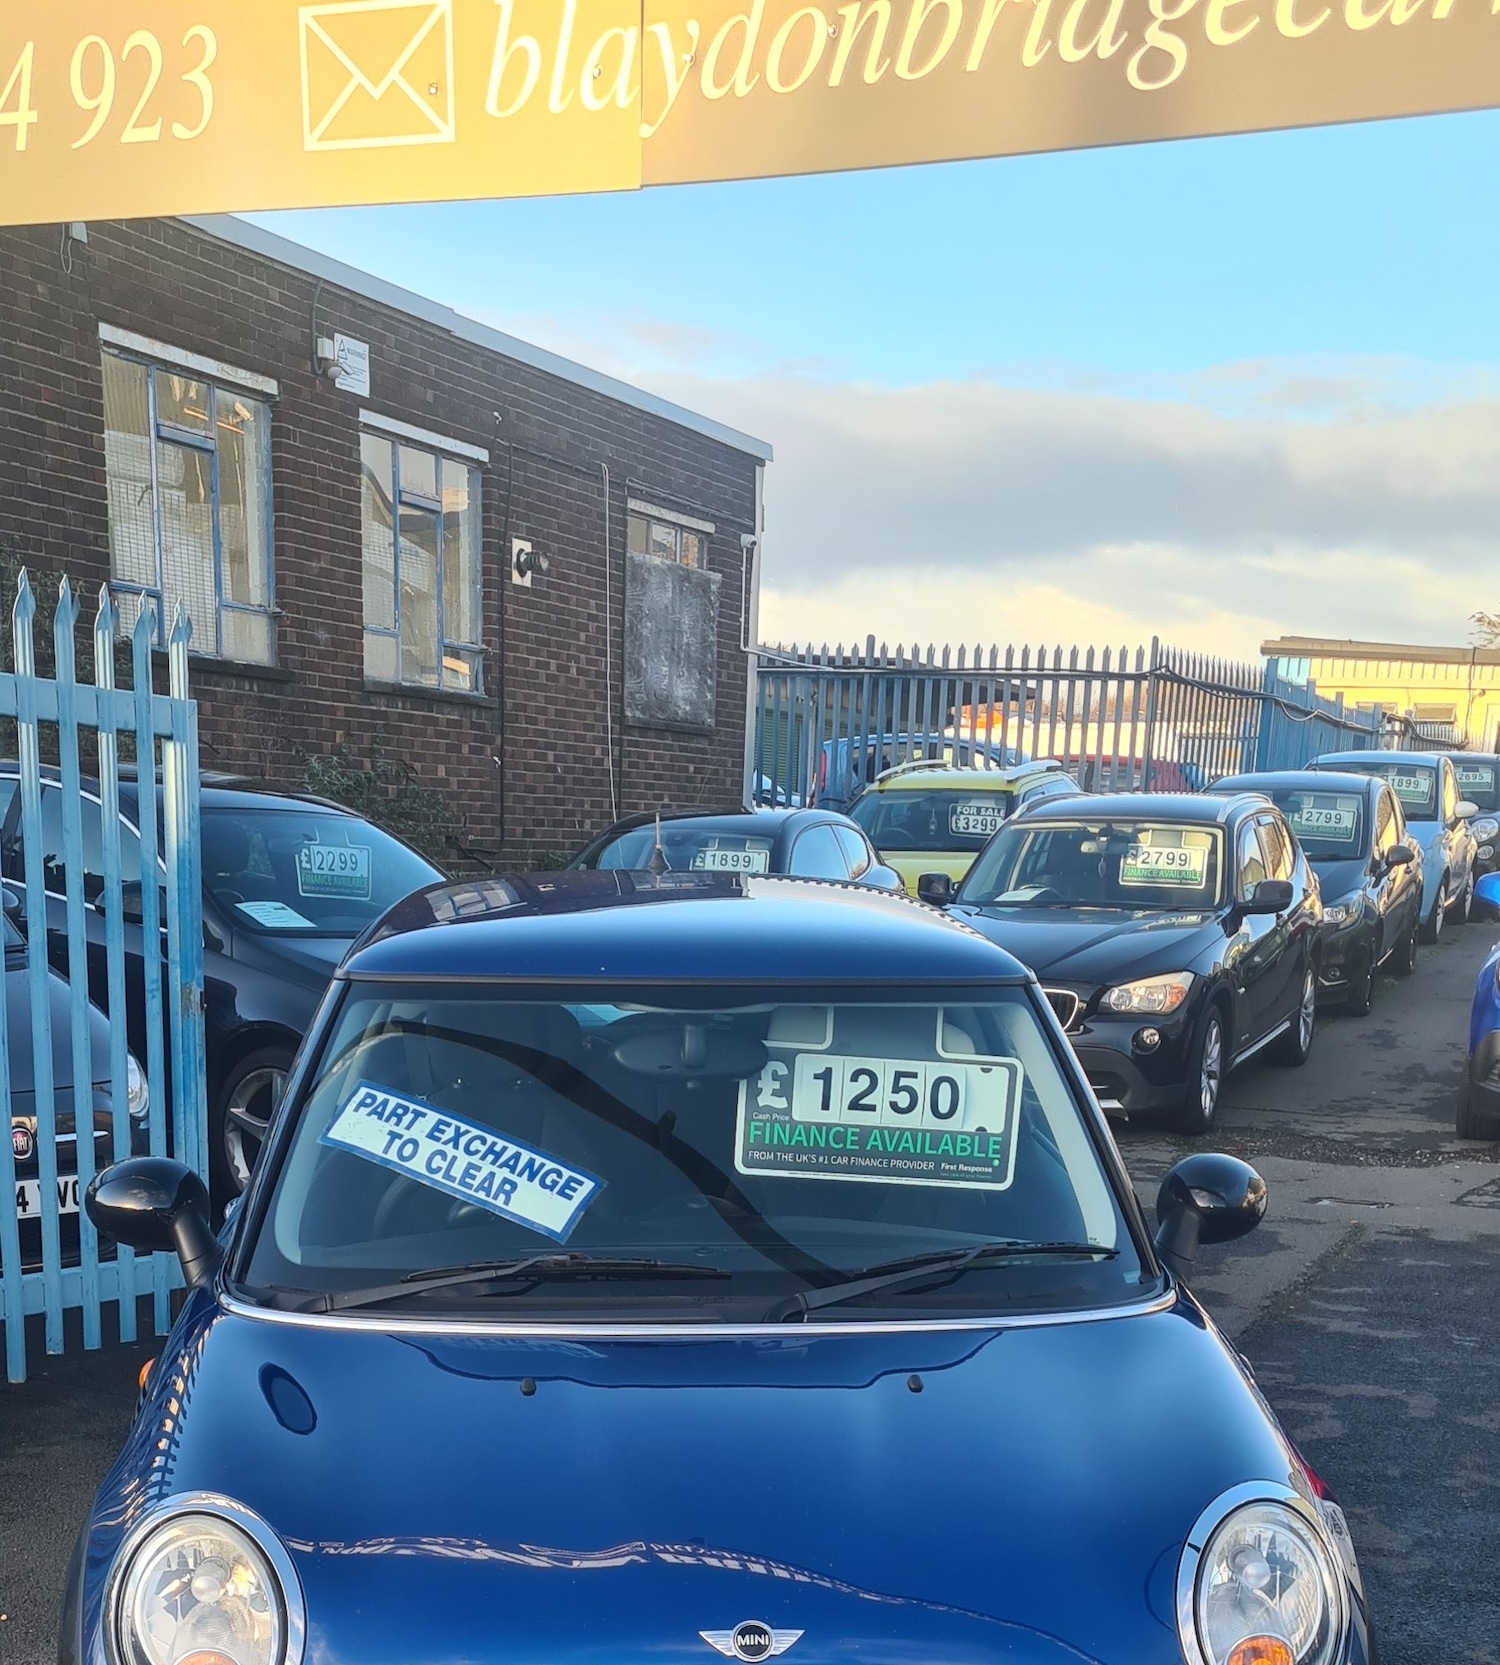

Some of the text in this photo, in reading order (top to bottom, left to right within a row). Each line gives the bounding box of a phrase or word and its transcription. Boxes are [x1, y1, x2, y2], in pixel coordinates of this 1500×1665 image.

[70, 25, 218, 150] 923
[957, 806, 977, 815] FOR
[752, 1111, 790, 1121] Cash Price
[352, 1091, 585, 1201] PART EXCHANGE
[749, 1121, 1003, 1158] FINANCE AVAILABLE
[382, 1130, 518, 1206] TO CLEAR
[748, 1150, 935, 1171] FROM THE UK'S #1 CAR FINANCE PROVIDER
[941, 1162, 993, 1173] First Response
[738, 1634, 769, 1646] MINI
